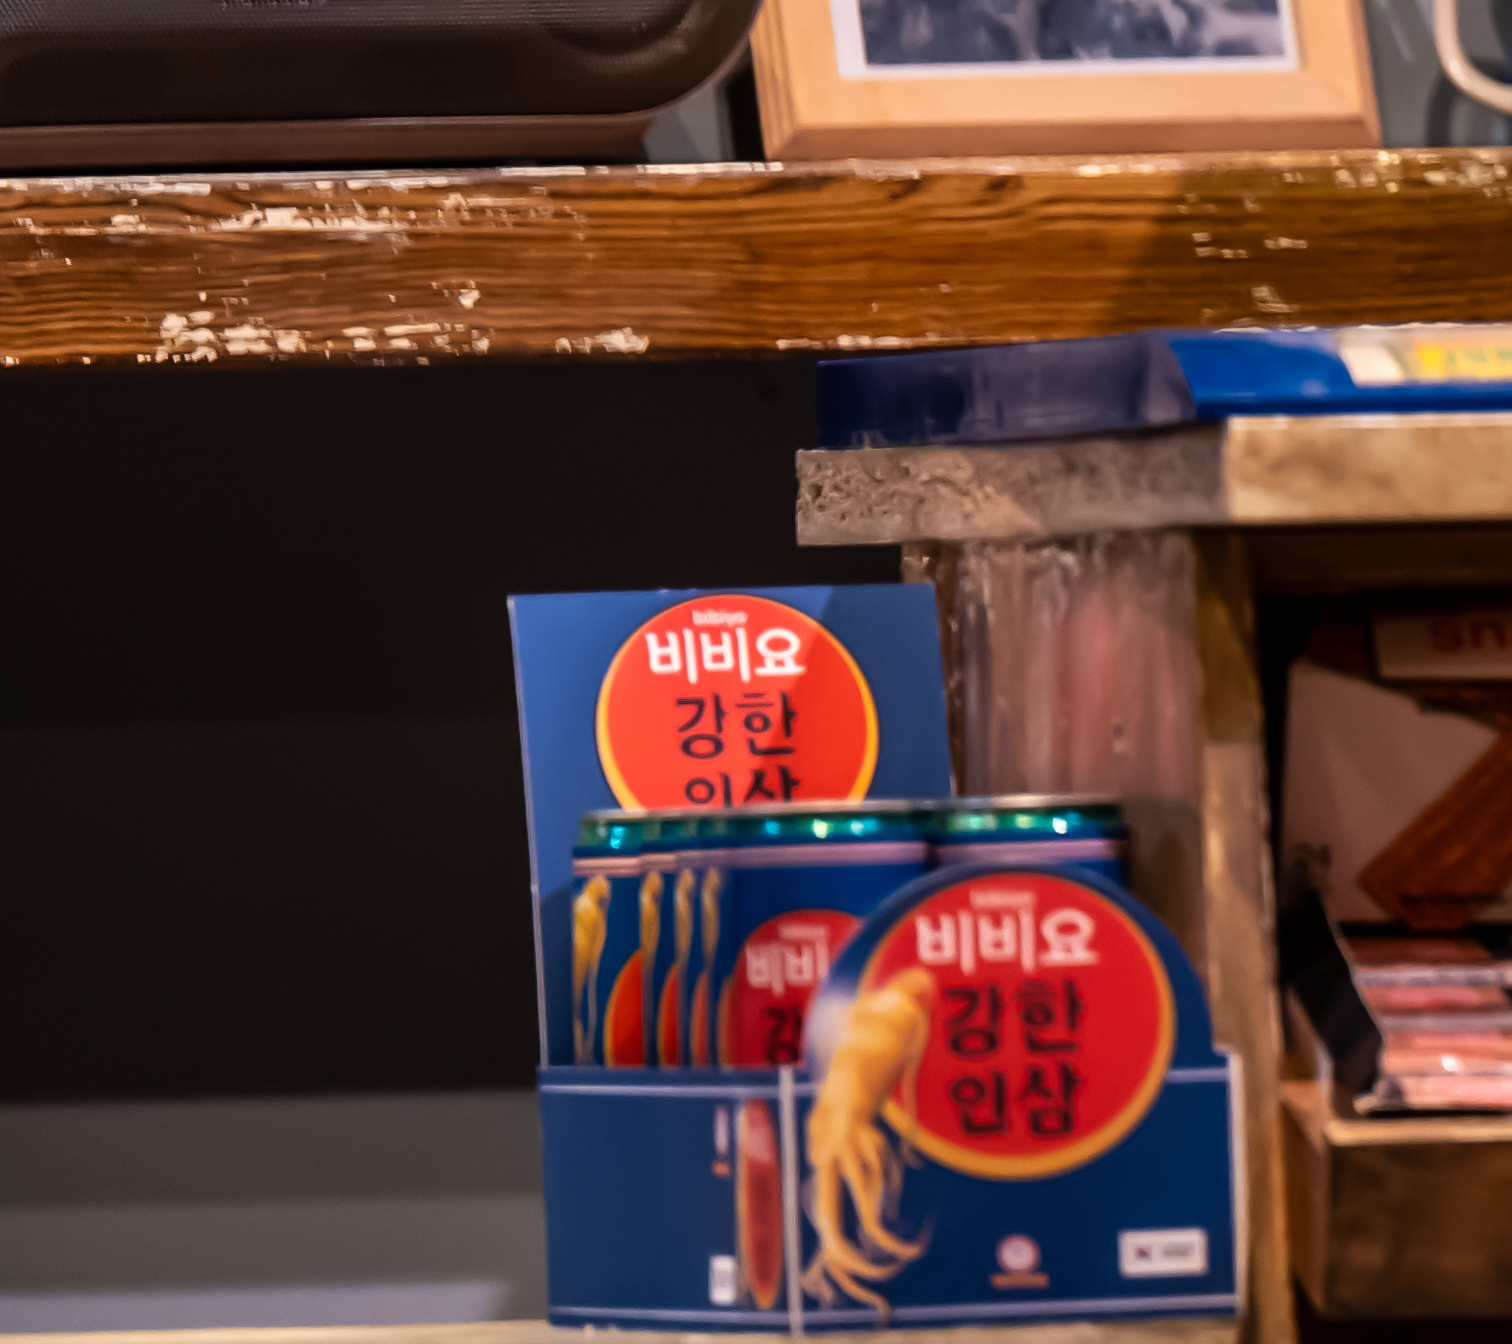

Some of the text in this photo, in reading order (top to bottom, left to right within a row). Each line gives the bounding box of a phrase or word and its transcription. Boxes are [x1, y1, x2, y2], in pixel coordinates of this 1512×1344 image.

[645, 627, 806, 684] 비비요
[674, 691, 797, 759] 강한
[744, 941, 831, 999] 비비
[915, 909, 1098, 974] 비비요
[944, 978, 1085, 1059] 강한
[949, 1062, 1083, 1138] 인삼
